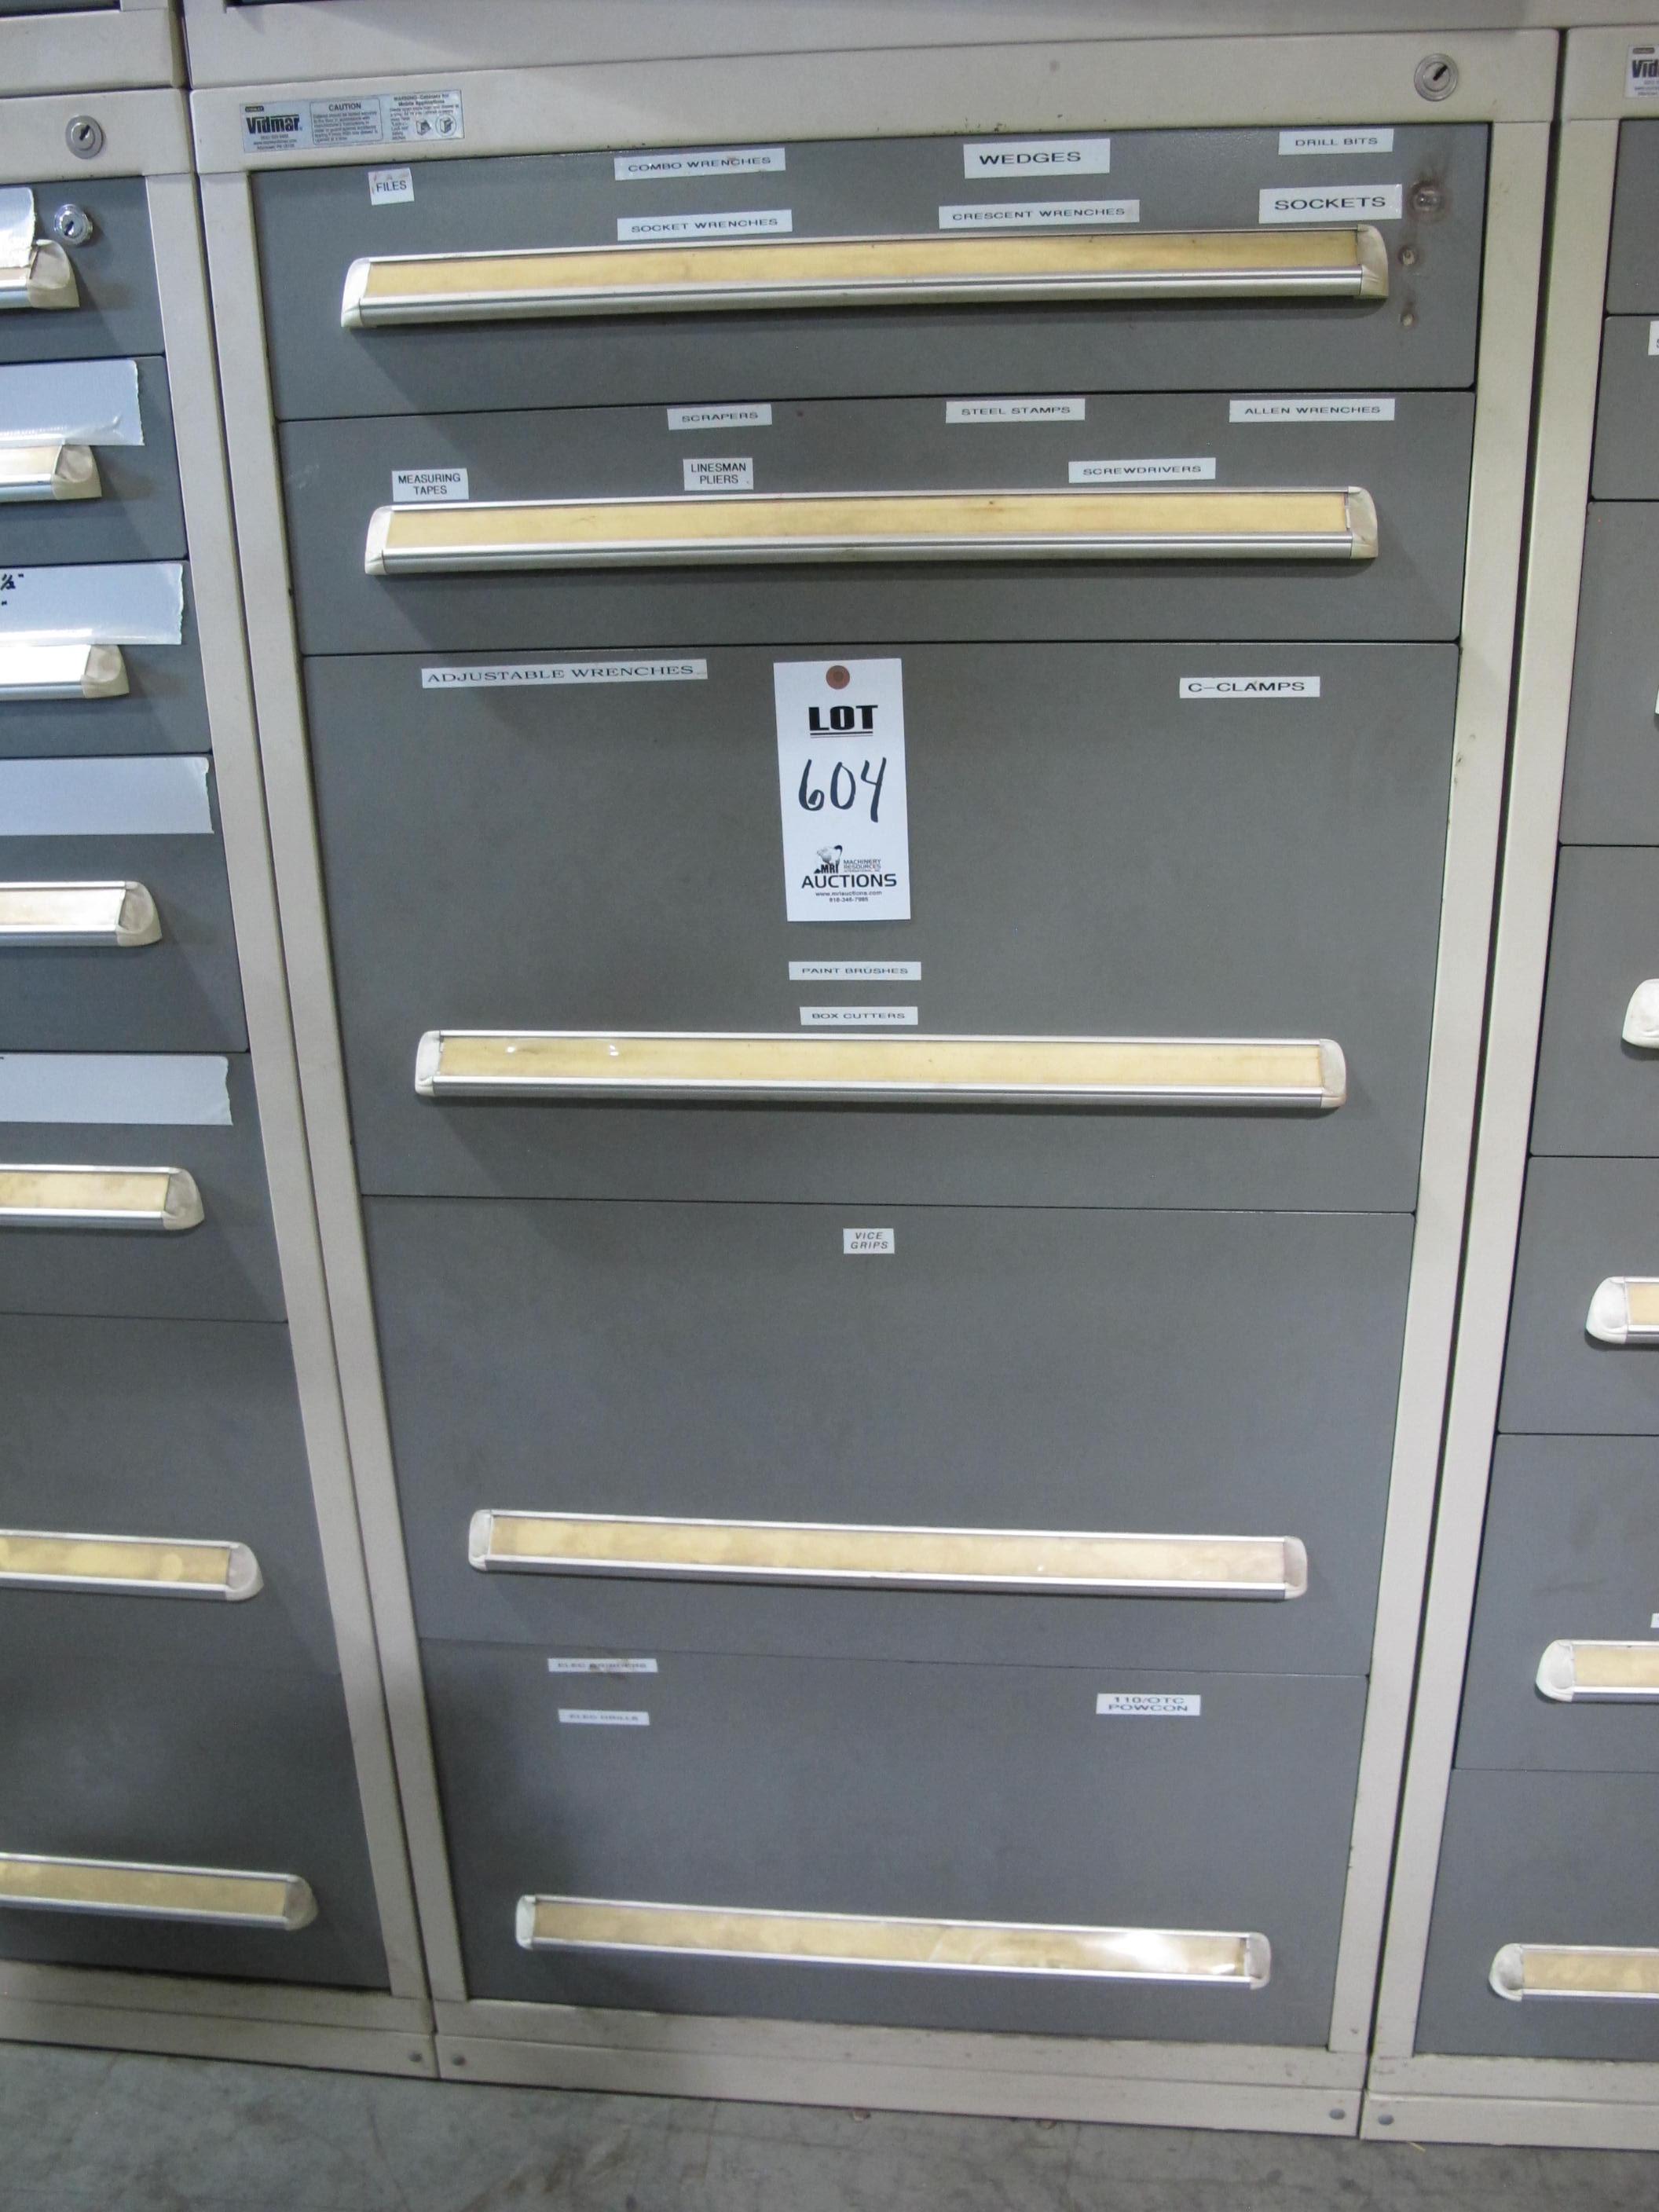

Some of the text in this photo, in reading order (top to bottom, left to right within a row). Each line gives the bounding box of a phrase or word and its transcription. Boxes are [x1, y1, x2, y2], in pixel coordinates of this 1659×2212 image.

[328, 102, 361, 112] CAUTION
[246, 114, 299, 134] Vidmar
[628, 156, 771, 172] COMBO WRENCHES
[980, 151, 1082, 165] WEDGES
[375, 180, 407, 192] FILES
[1275, 196, 1386, 211] SOCKETS
[952, 207, 1126, 221] CRESCENT WRENCHES
[632, 218, 778, 233] SOCKET WRENCHES
[682, 412, 759, 423] SCRAPERS
[690, 463, 746, 473] LINESMAN
[1082, 466, 1202, 475] SCREWDRIVERS
[398, 473, 461, 484] MEASURING
[699, 474, 738, 485] PLIERS
[413, 485, 447, 495] TAPES
[427, 665, 694, 683] ADJUSTABLE WRENCHES
[1188, 682, 1305, 692] C-CLAMPS
[808, 705, 878, 731] LOT
[798, 756, 887, 823] 604
[820, 862, 838, 873] MRI
[801, 873, 897, 888] AUCTIONS
